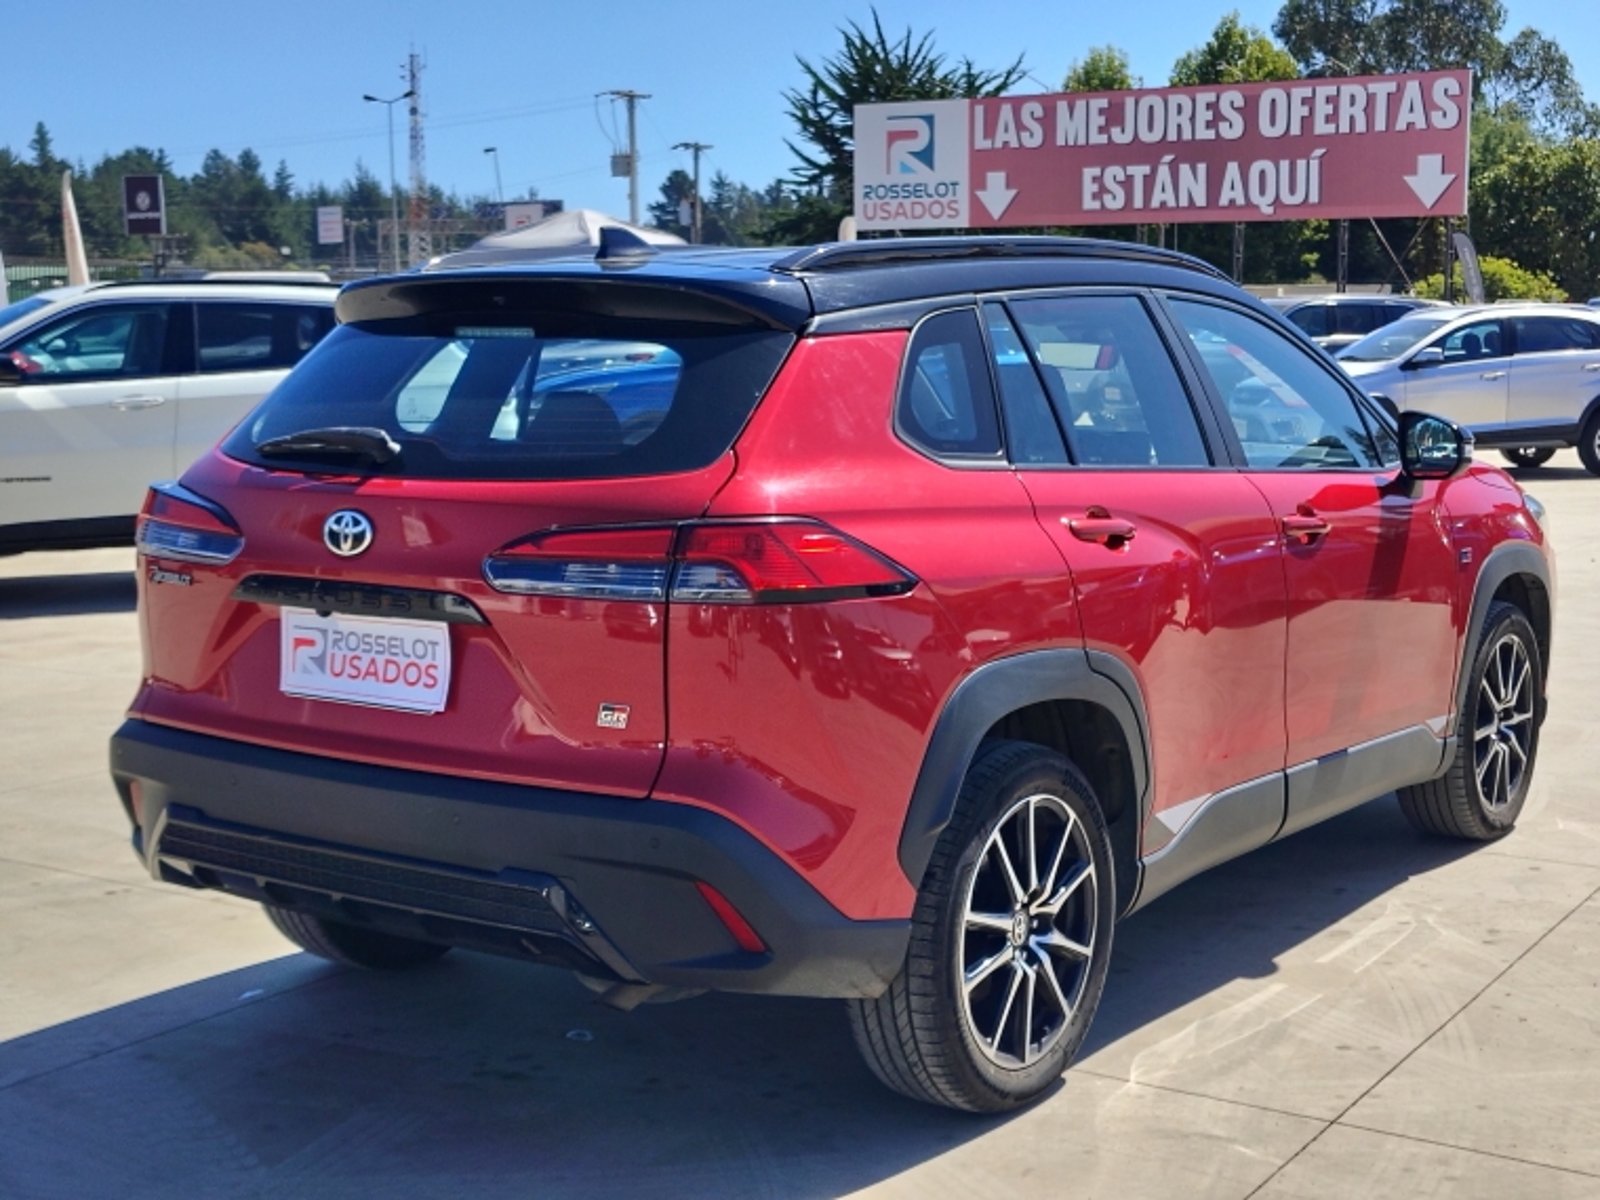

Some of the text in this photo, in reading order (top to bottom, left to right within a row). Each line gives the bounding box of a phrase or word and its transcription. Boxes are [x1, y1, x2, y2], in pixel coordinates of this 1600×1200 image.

[973, 76, 1462, 150] LAS MEJORES OFERTAS
[862, 181, 960, 201] ROSSELOT
[1081, 148, 1328, 215] ESTÁN AQUÍ
[862, 200, 961, 221] USADOS
[332, 629, 440, 662] ROSSELOT
[329, 652, 439, 690] USADOS
